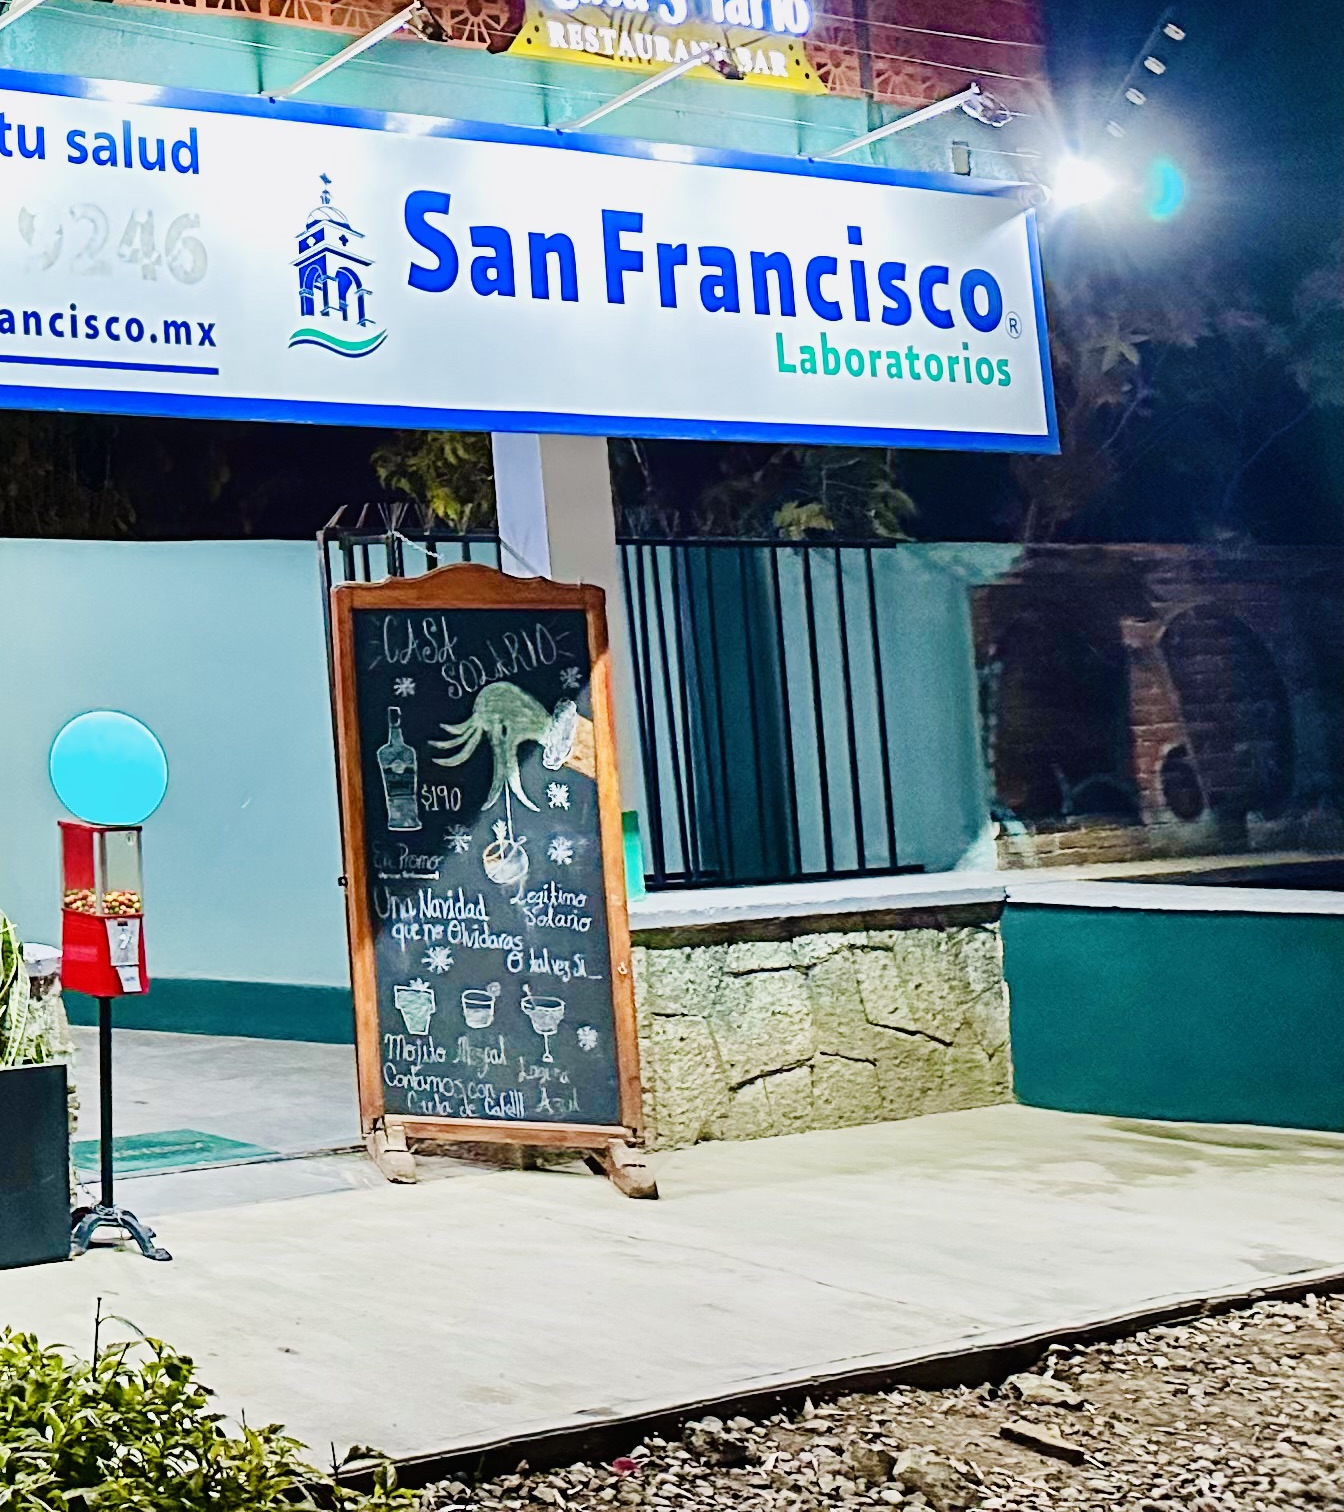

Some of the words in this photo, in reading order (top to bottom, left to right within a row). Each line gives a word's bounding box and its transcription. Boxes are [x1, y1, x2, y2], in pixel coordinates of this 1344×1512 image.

[547, 21, 727, 64] RESTAURAN
[736, 46, 789, 77] BAR
[67, 121, 200, 175] salud
[17, 200, 209, 284] 9246
[404, 189, 579, 303] San
[602, 209, 1004, 334] Francisco
[777, 332, 1013, 387] Laboratorios
[381, 615, 458, 665] CASA
[421, 784, 461, 812] $190
[398, 842, 444, 871] Promo
[374, 886, 417, 920] Una
[419, 886, 490, 921] Navidad
[391, 922, 422, 953] que
[384, 1033, 447, 1071] Mojito
